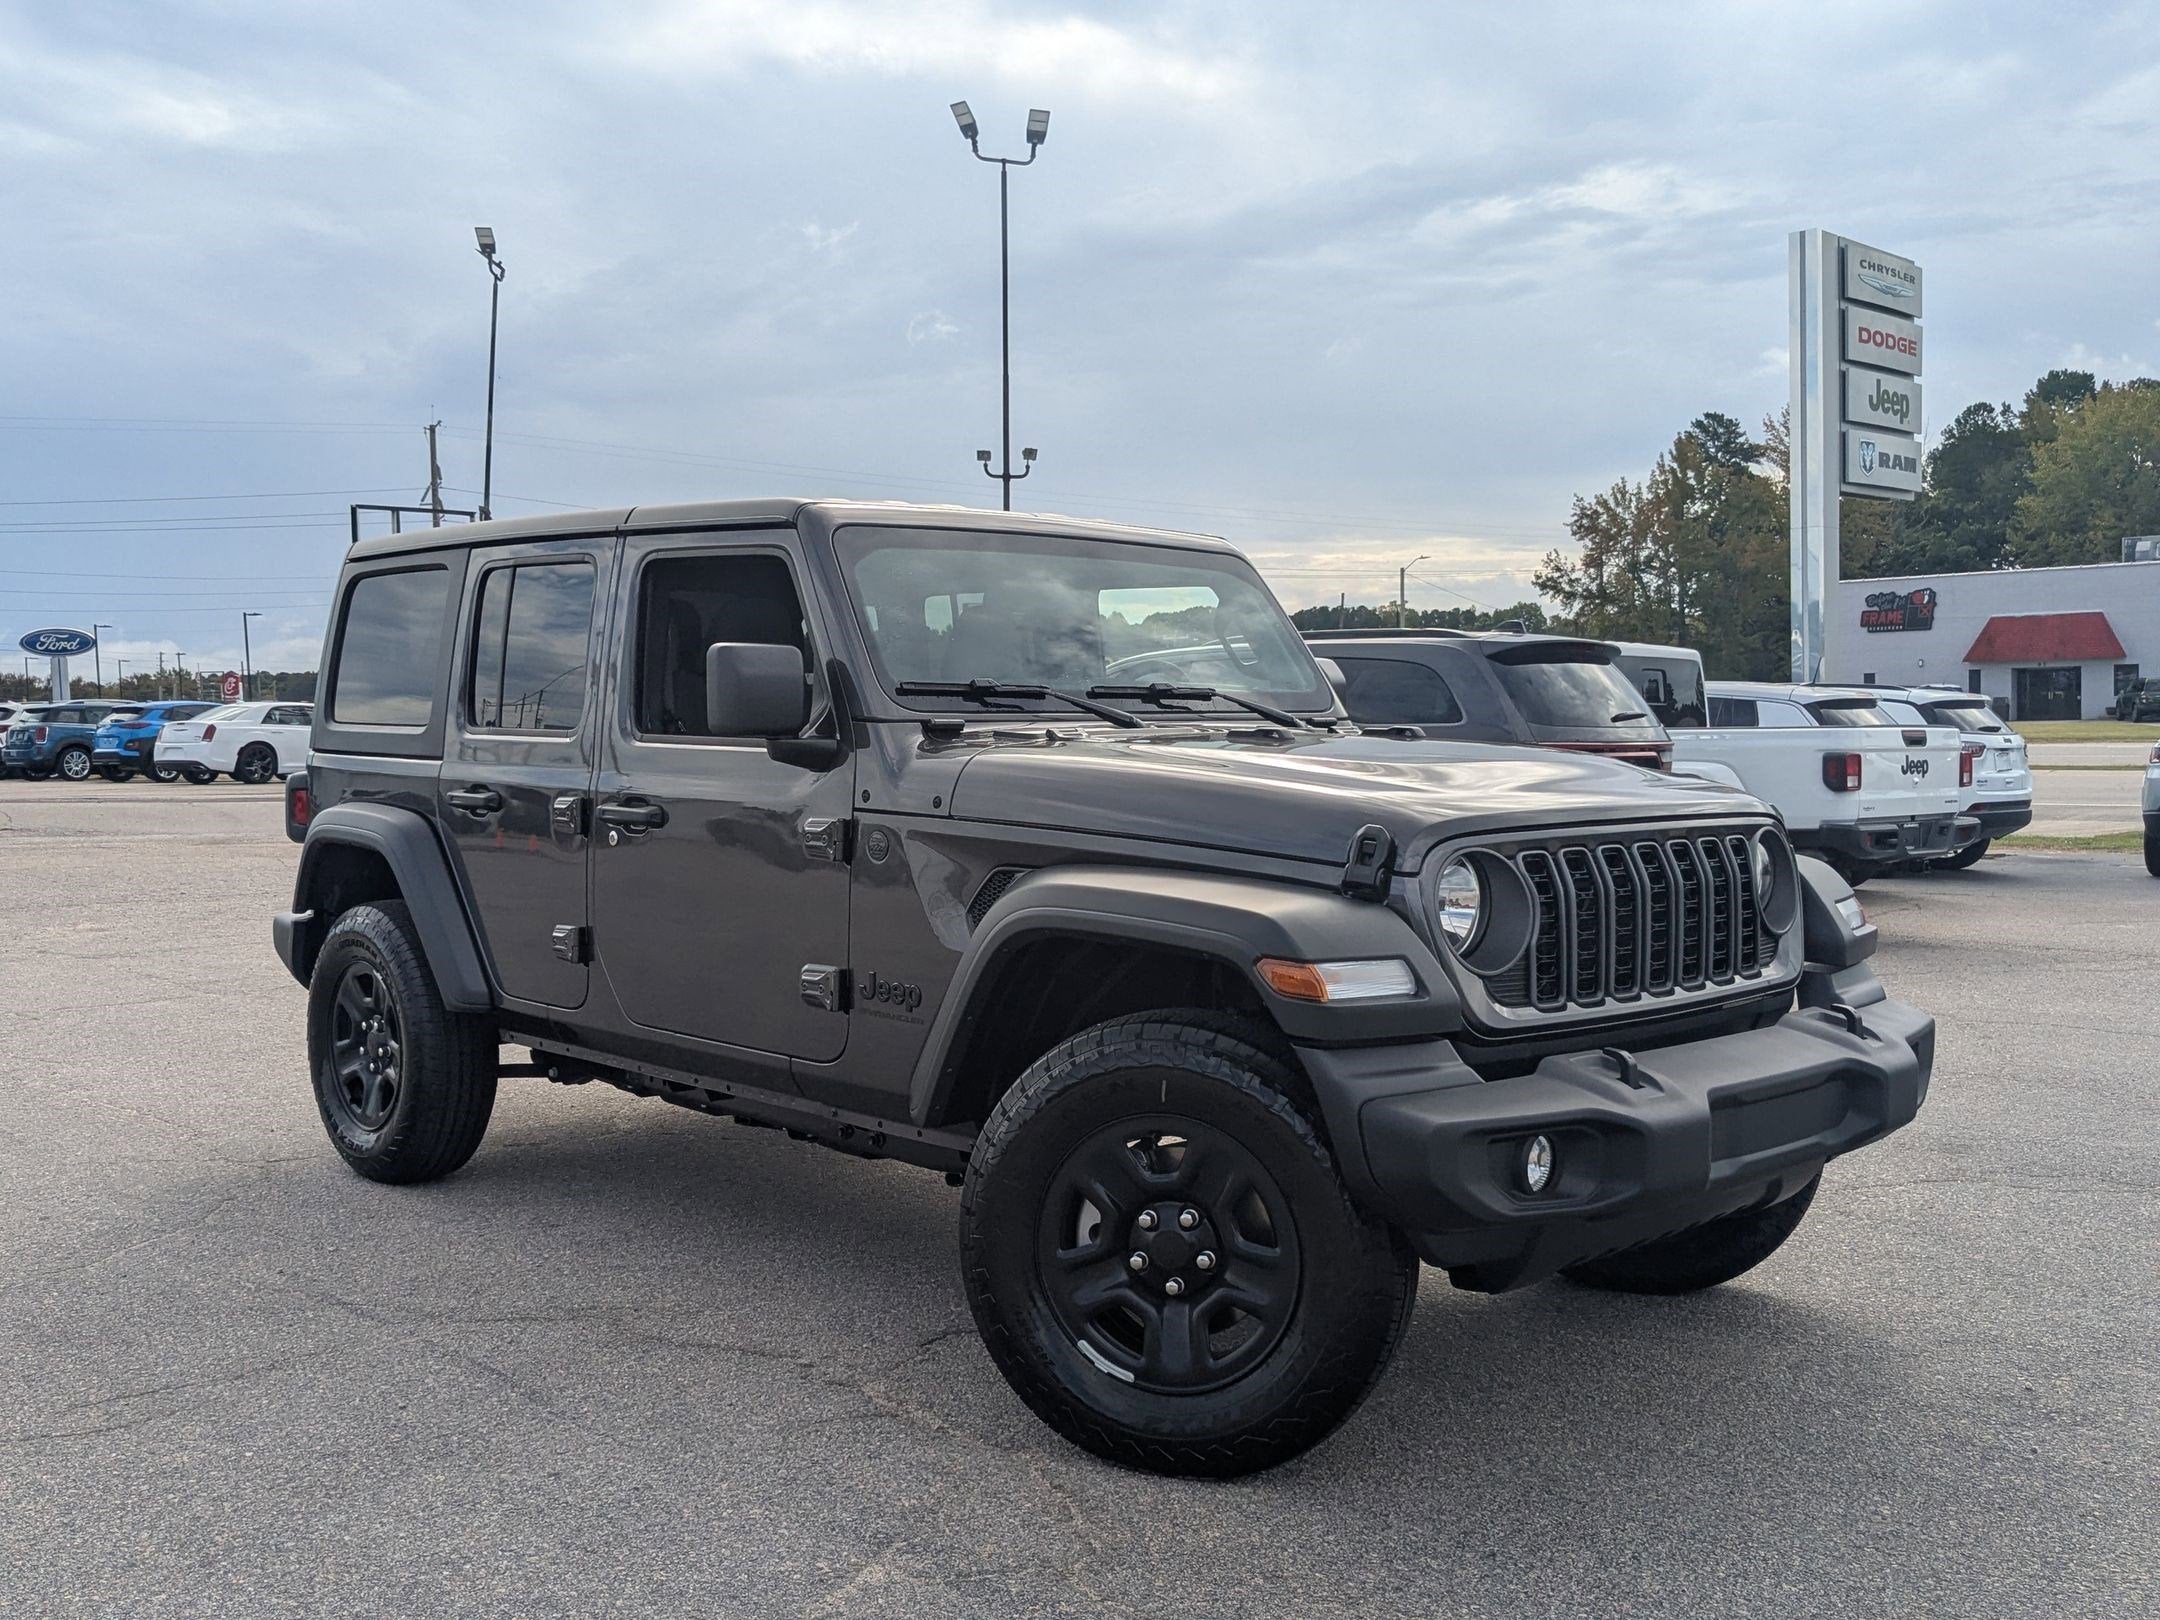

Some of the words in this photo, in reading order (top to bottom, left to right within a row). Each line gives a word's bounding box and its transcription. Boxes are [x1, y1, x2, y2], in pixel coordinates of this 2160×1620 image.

[1859, 259, 1916, 285] CHRYSLER
[1858, 326, 1918, 357] DODGE
[1868, 378, 1910, 424] Jeep
[1878, 451, 1917, 474] RAM
[36, 633, 80, 650] Ford
[1901, 754, 1929, 778] Jeep
[859, 971, 922, 1012] Jeep
